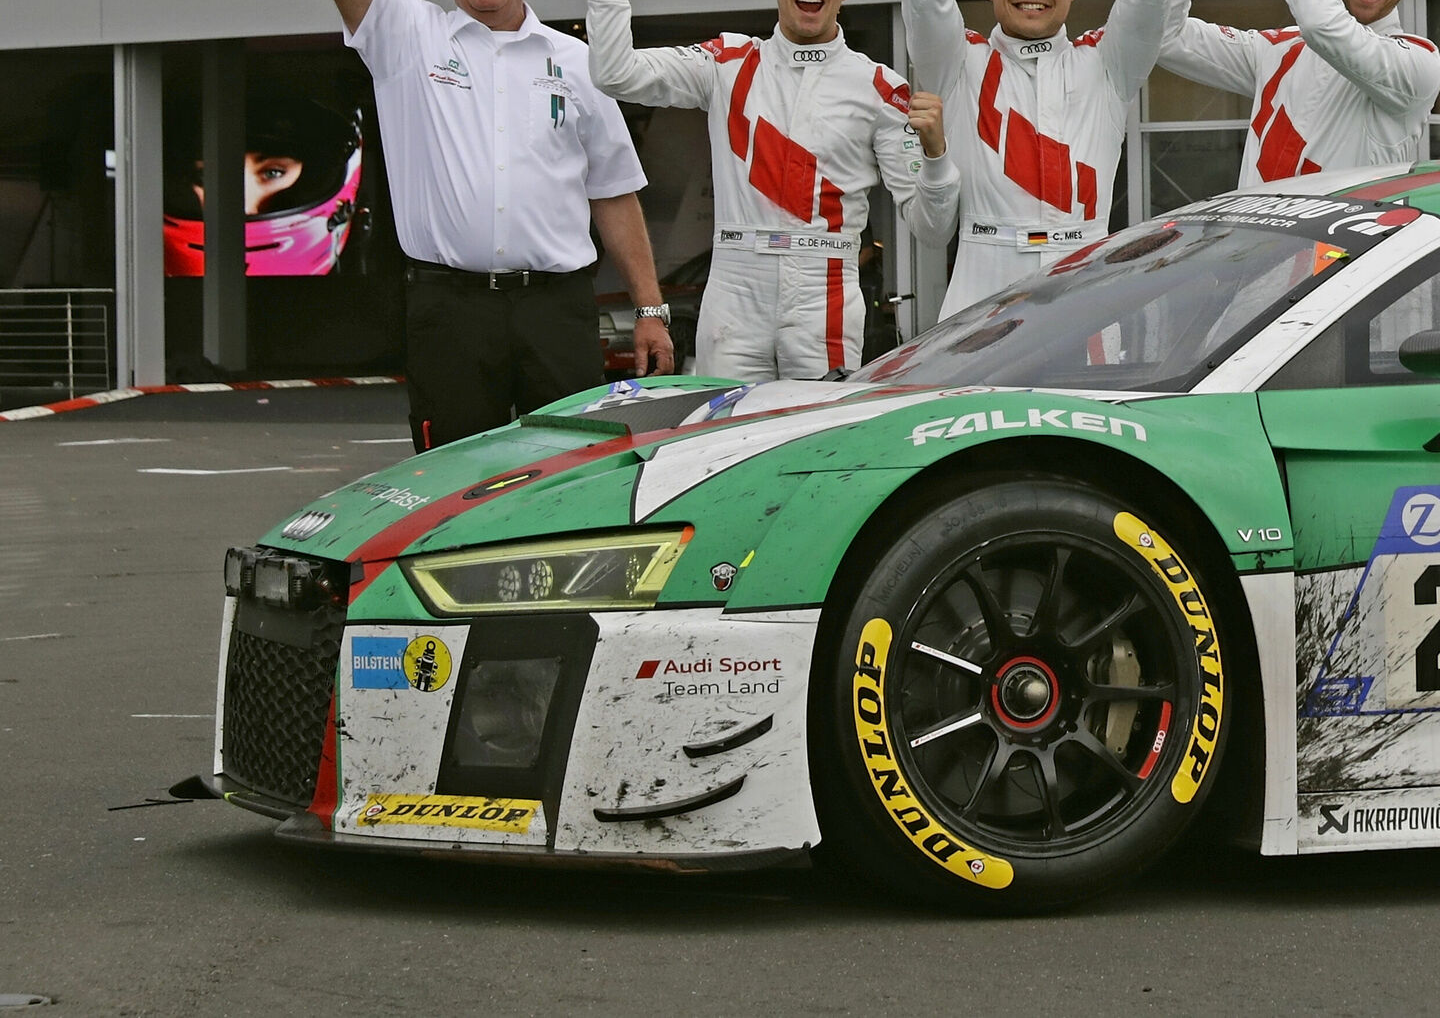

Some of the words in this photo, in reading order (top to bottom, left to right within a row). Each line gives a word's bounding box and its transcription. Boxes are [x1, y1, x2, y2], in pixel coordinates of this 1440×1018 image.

[1205, 196, 1350, 220] TURISMO
[808, 238, 819, 248] DE
[1052, 231, 1063, 241] C.
[1064, 230, 1083, 241] MIES
[904, 408, 1147, 446] FALKEN
[353, 655, 402, 671] BILSTEIN
[663, 658, 712, 675] Audi
[719, 657, 782, 676] Sport
[1153, 553, 1220, 785] DUNLOP
[663, 681, 720, 696] Team
[727, 679, 780, 695] Land
[858, 642, 965, 864] DUNLOP
[387, 804, 530, 822] DUNLOP
